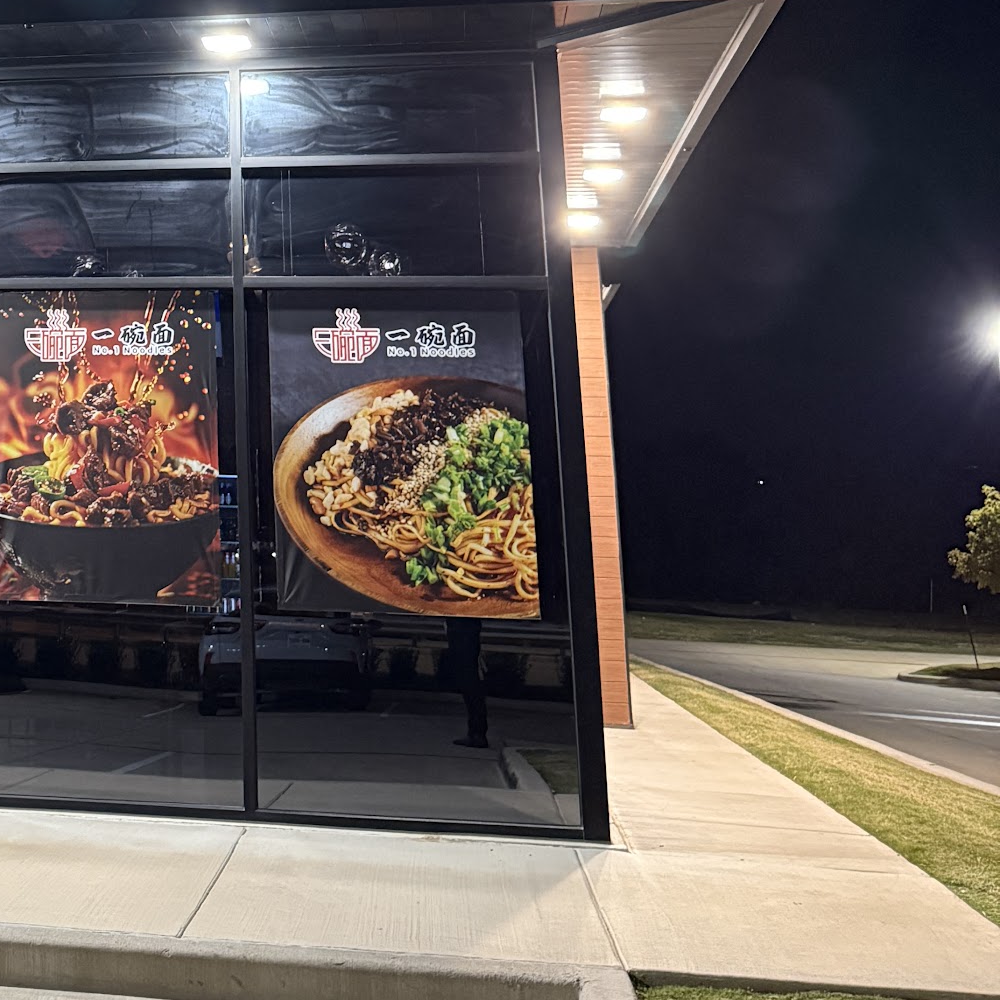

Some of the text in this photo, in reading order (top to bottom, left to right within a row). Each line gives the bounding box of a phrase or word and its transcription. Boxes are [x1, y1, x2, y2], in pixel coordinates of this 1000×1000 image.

[92, 322, 174, 347] 一碗面
[386, 322, 476, 347] 一碗面
[92, 345, 174, 356] No.1 Noodles
[387, 346, 476, 357] No.1 Noodles
